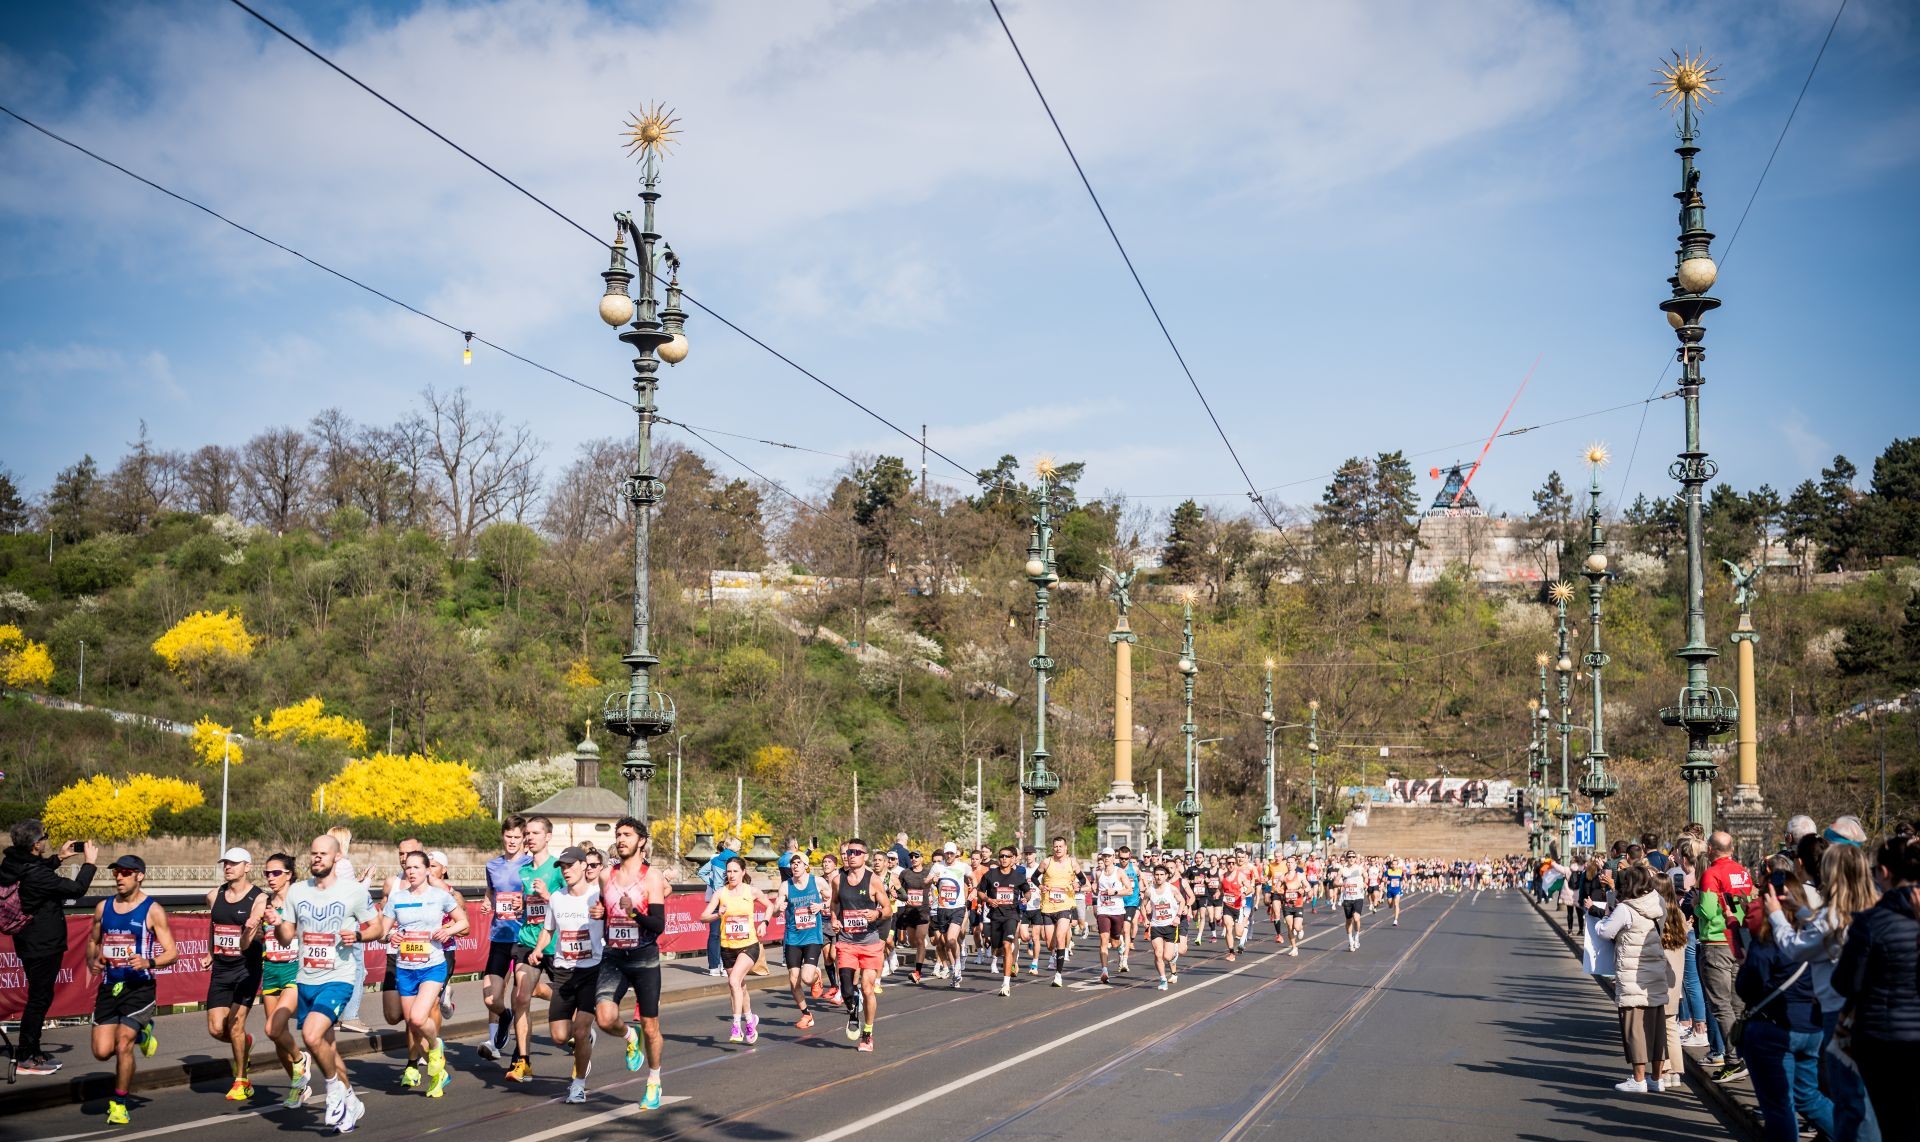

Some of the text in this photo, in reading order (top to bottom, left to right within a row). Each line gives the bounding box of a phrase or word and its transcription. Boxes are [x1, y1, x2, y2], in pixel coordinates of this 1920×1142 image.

[615, 929, 630, 938] 261
[220, 937, 233, 946] 279
[176, 940, 208, 954] ENERALI
[570, 942, 583, 951] 141
[112, 947, 126, 957] 175
[308, 947, 327, 958] 266
